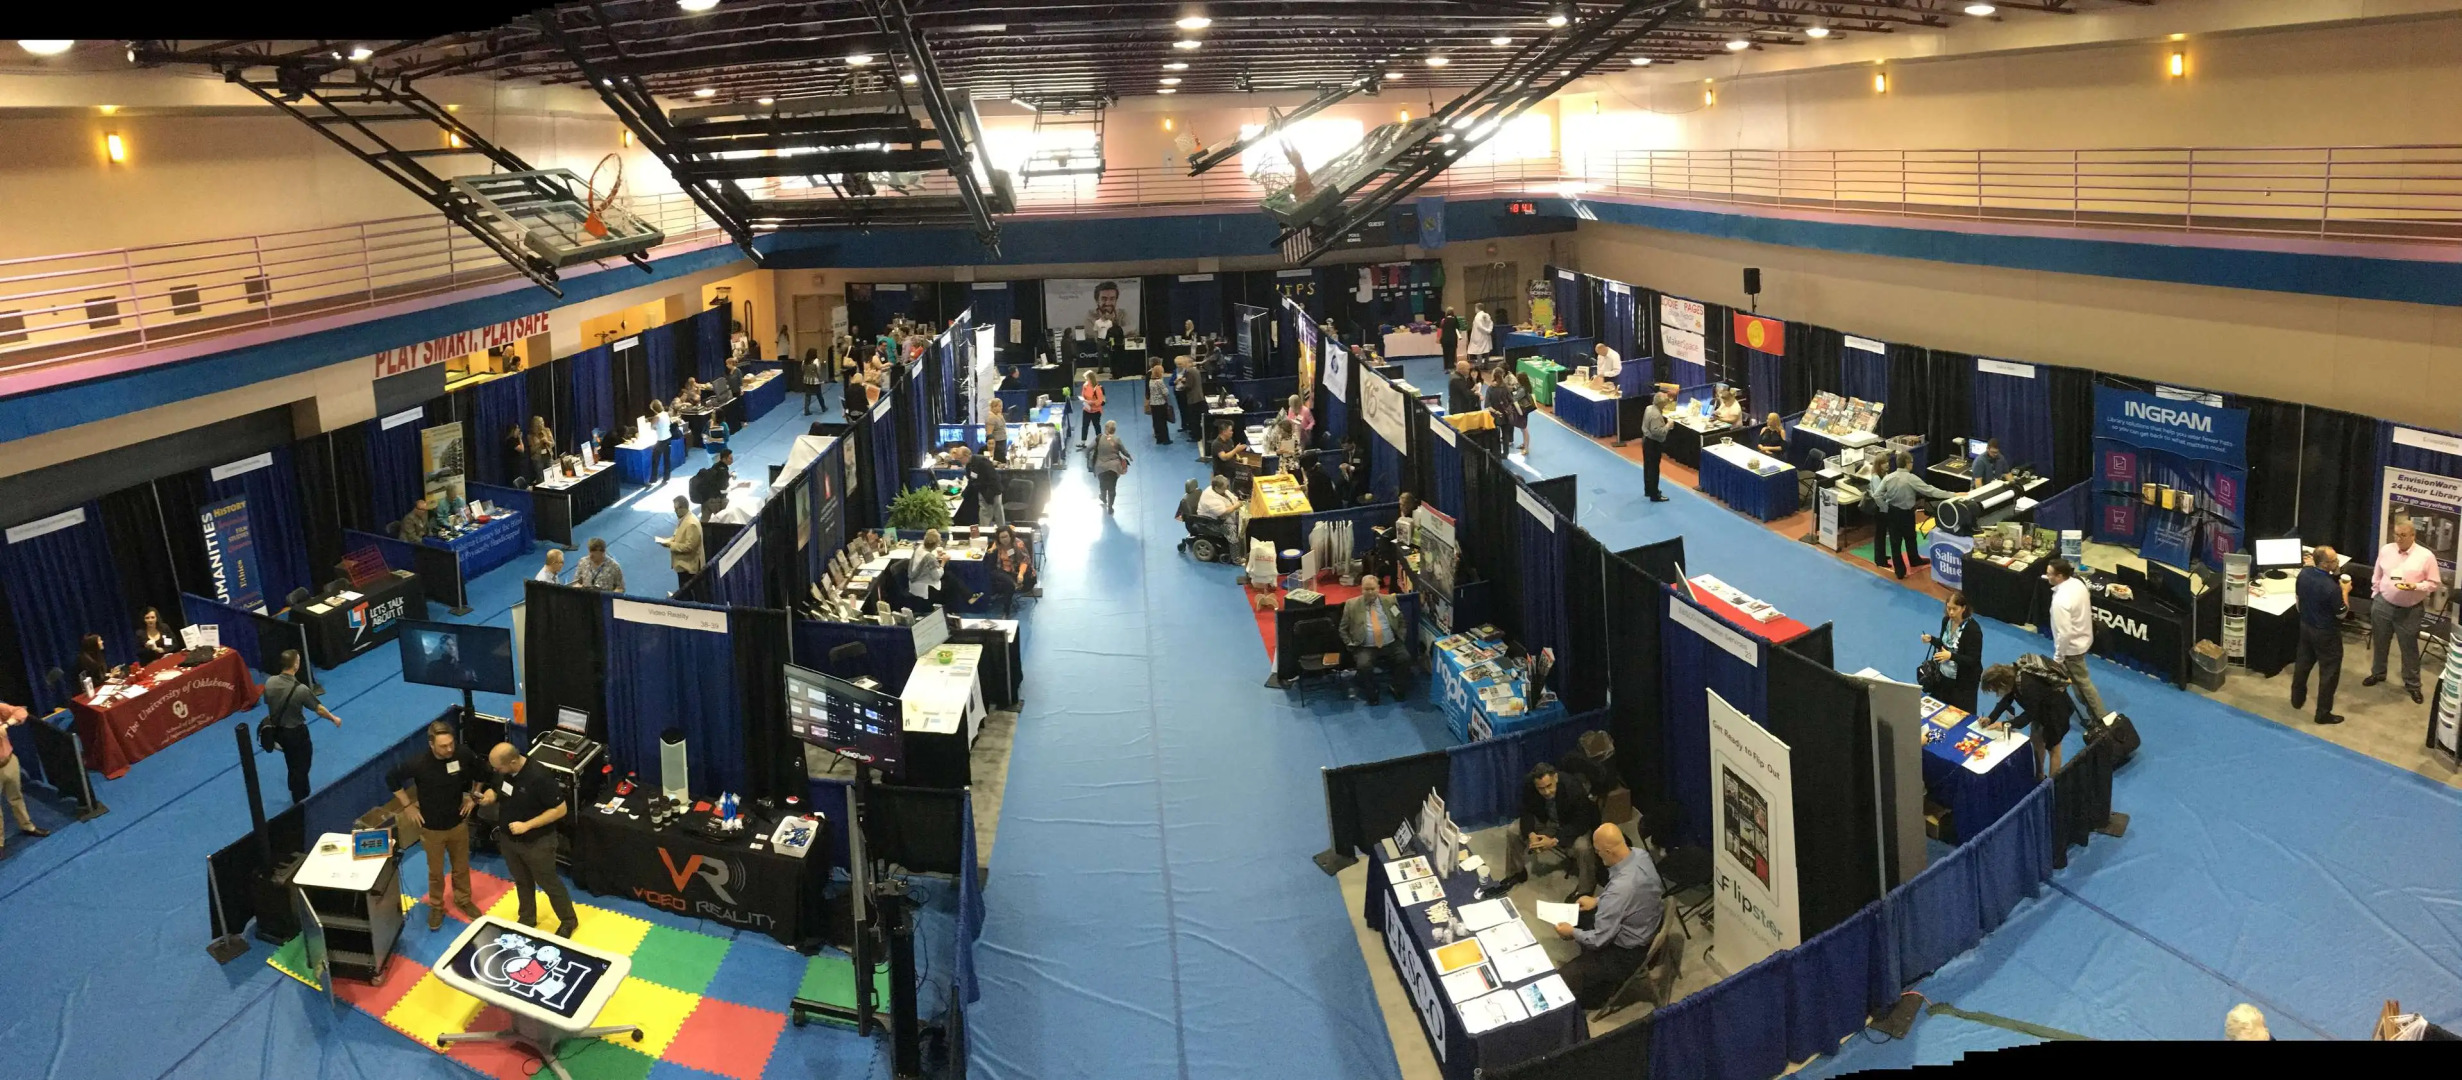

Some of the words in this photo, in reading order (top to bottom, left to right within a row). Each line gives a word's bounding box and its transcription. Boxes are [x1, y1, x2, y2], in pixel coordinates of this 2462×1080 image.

[1683, 302, 1704, 316] PAGES
[375, 343, 421, 378] PLAY
[2107, 416, 2125, 426] Library
[2125, 421, 2150, 430] solutions
[2162, 426, 2176, 436] help
[2124, 400, 2212, 432] INGRAM
[2149, 431, 2163, 439] back
[2186, 440, 2210, 450] matters
[2391, 482, 2428, 495] 24-Hour
[2430, 489, 2462, 502] Library
[2398, 474, 2458, 491] EnvisionWare
[2410, 498, 2419, 506] go
[201, 511, 230, 605] UMANITIES
[1935, 548, 1962, 565] Salin
[387, 597, 405, 612] TALK
[648, 608, 667, 617] Video
[667, 610, 689, 621] Reality
[372, 609, 397, 627] ABOUT
[396, 606, 404, 616] IT
[700, 620, 719, 630] 38-39
[125, 720, 139, 739] The
[138, 687, 181, 722] University
[182, 680, 193, 694] of
[193, 677, 236, 692] Oklahoma
[1712, 720, 1723, 736] Get
[1724, 727, 1744, 753] Ready
[1744, 746, 1753, 757] to
[1753, 752, 1765, 769] Flip
[1767, 761, 1781, 781] Out
[657, 846, 738, 906] VR
[632, 886, 686, 911] VIDEO
[696, 900, 777, 930] REALITY
[1720, 872, 1784, 942] Flipster
[1386, 901, 1442, 1042] EBSCO
